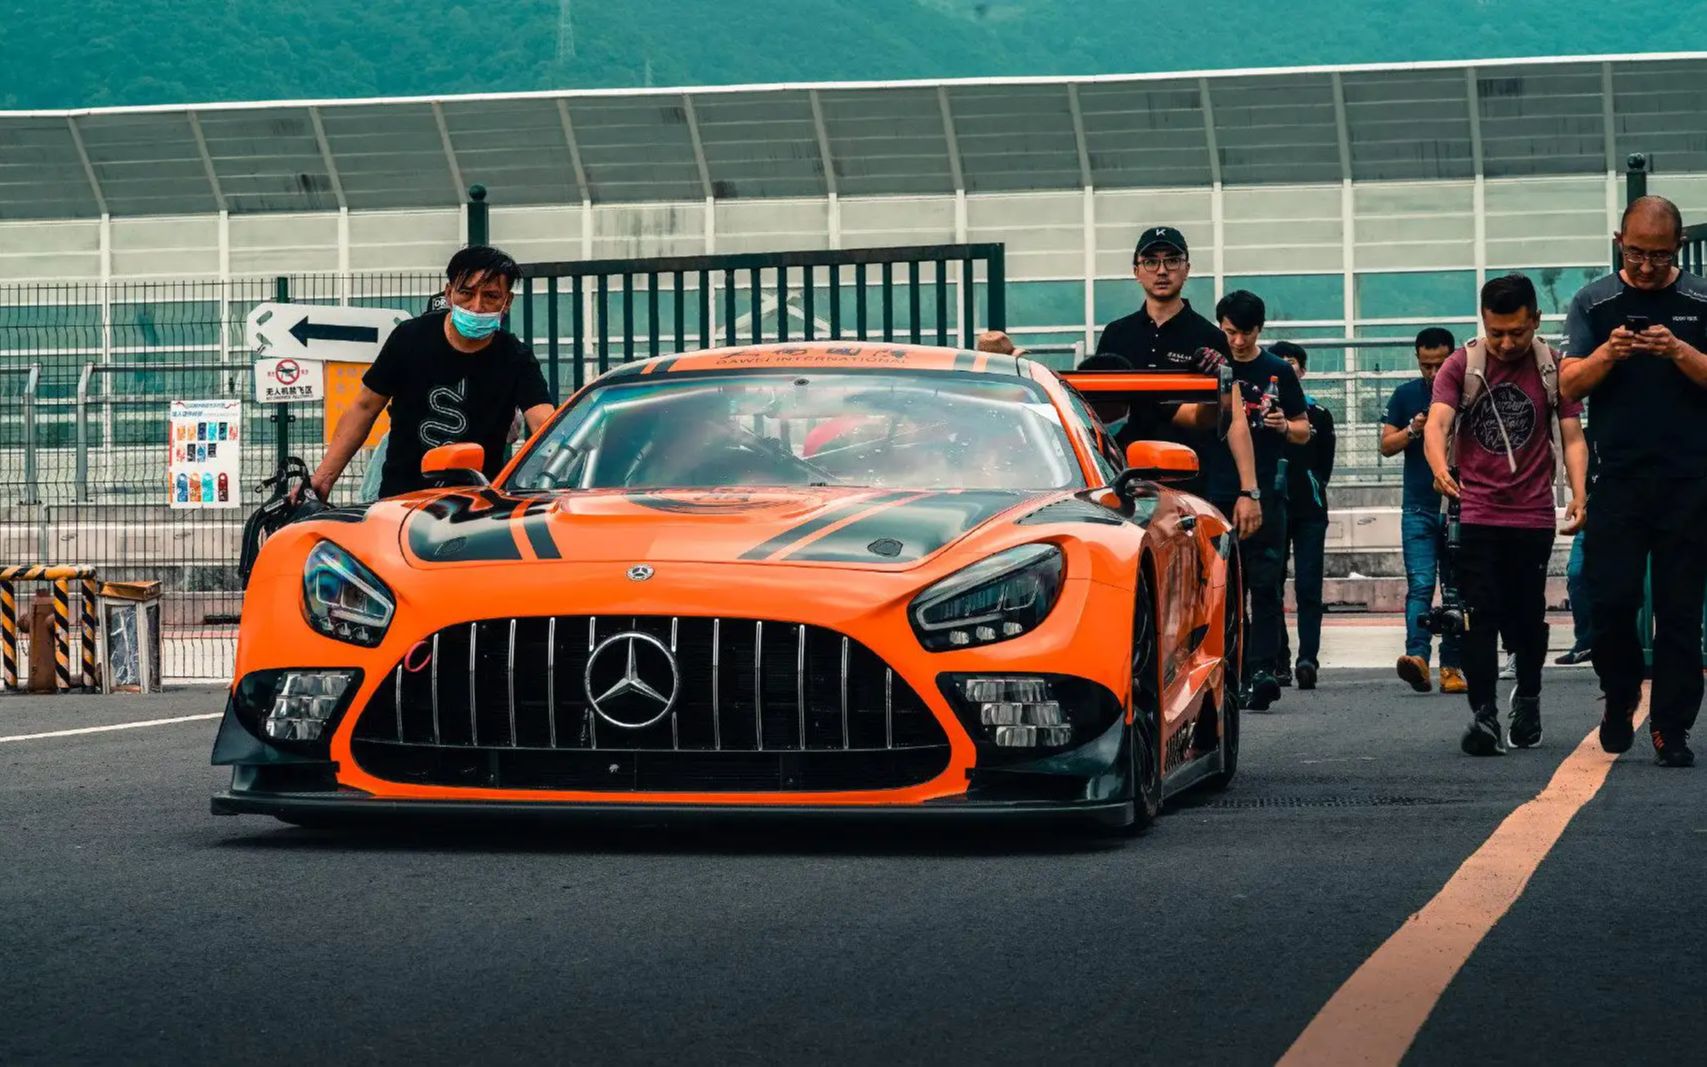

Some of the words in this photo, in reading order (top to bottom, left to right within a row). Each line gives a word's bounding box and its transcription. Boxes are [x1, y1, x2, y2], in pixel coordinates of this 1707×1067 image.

[774, 355, 905, 364] INTERNATIONAL
[266, 385, 313, 396] 无人机禁飞区
